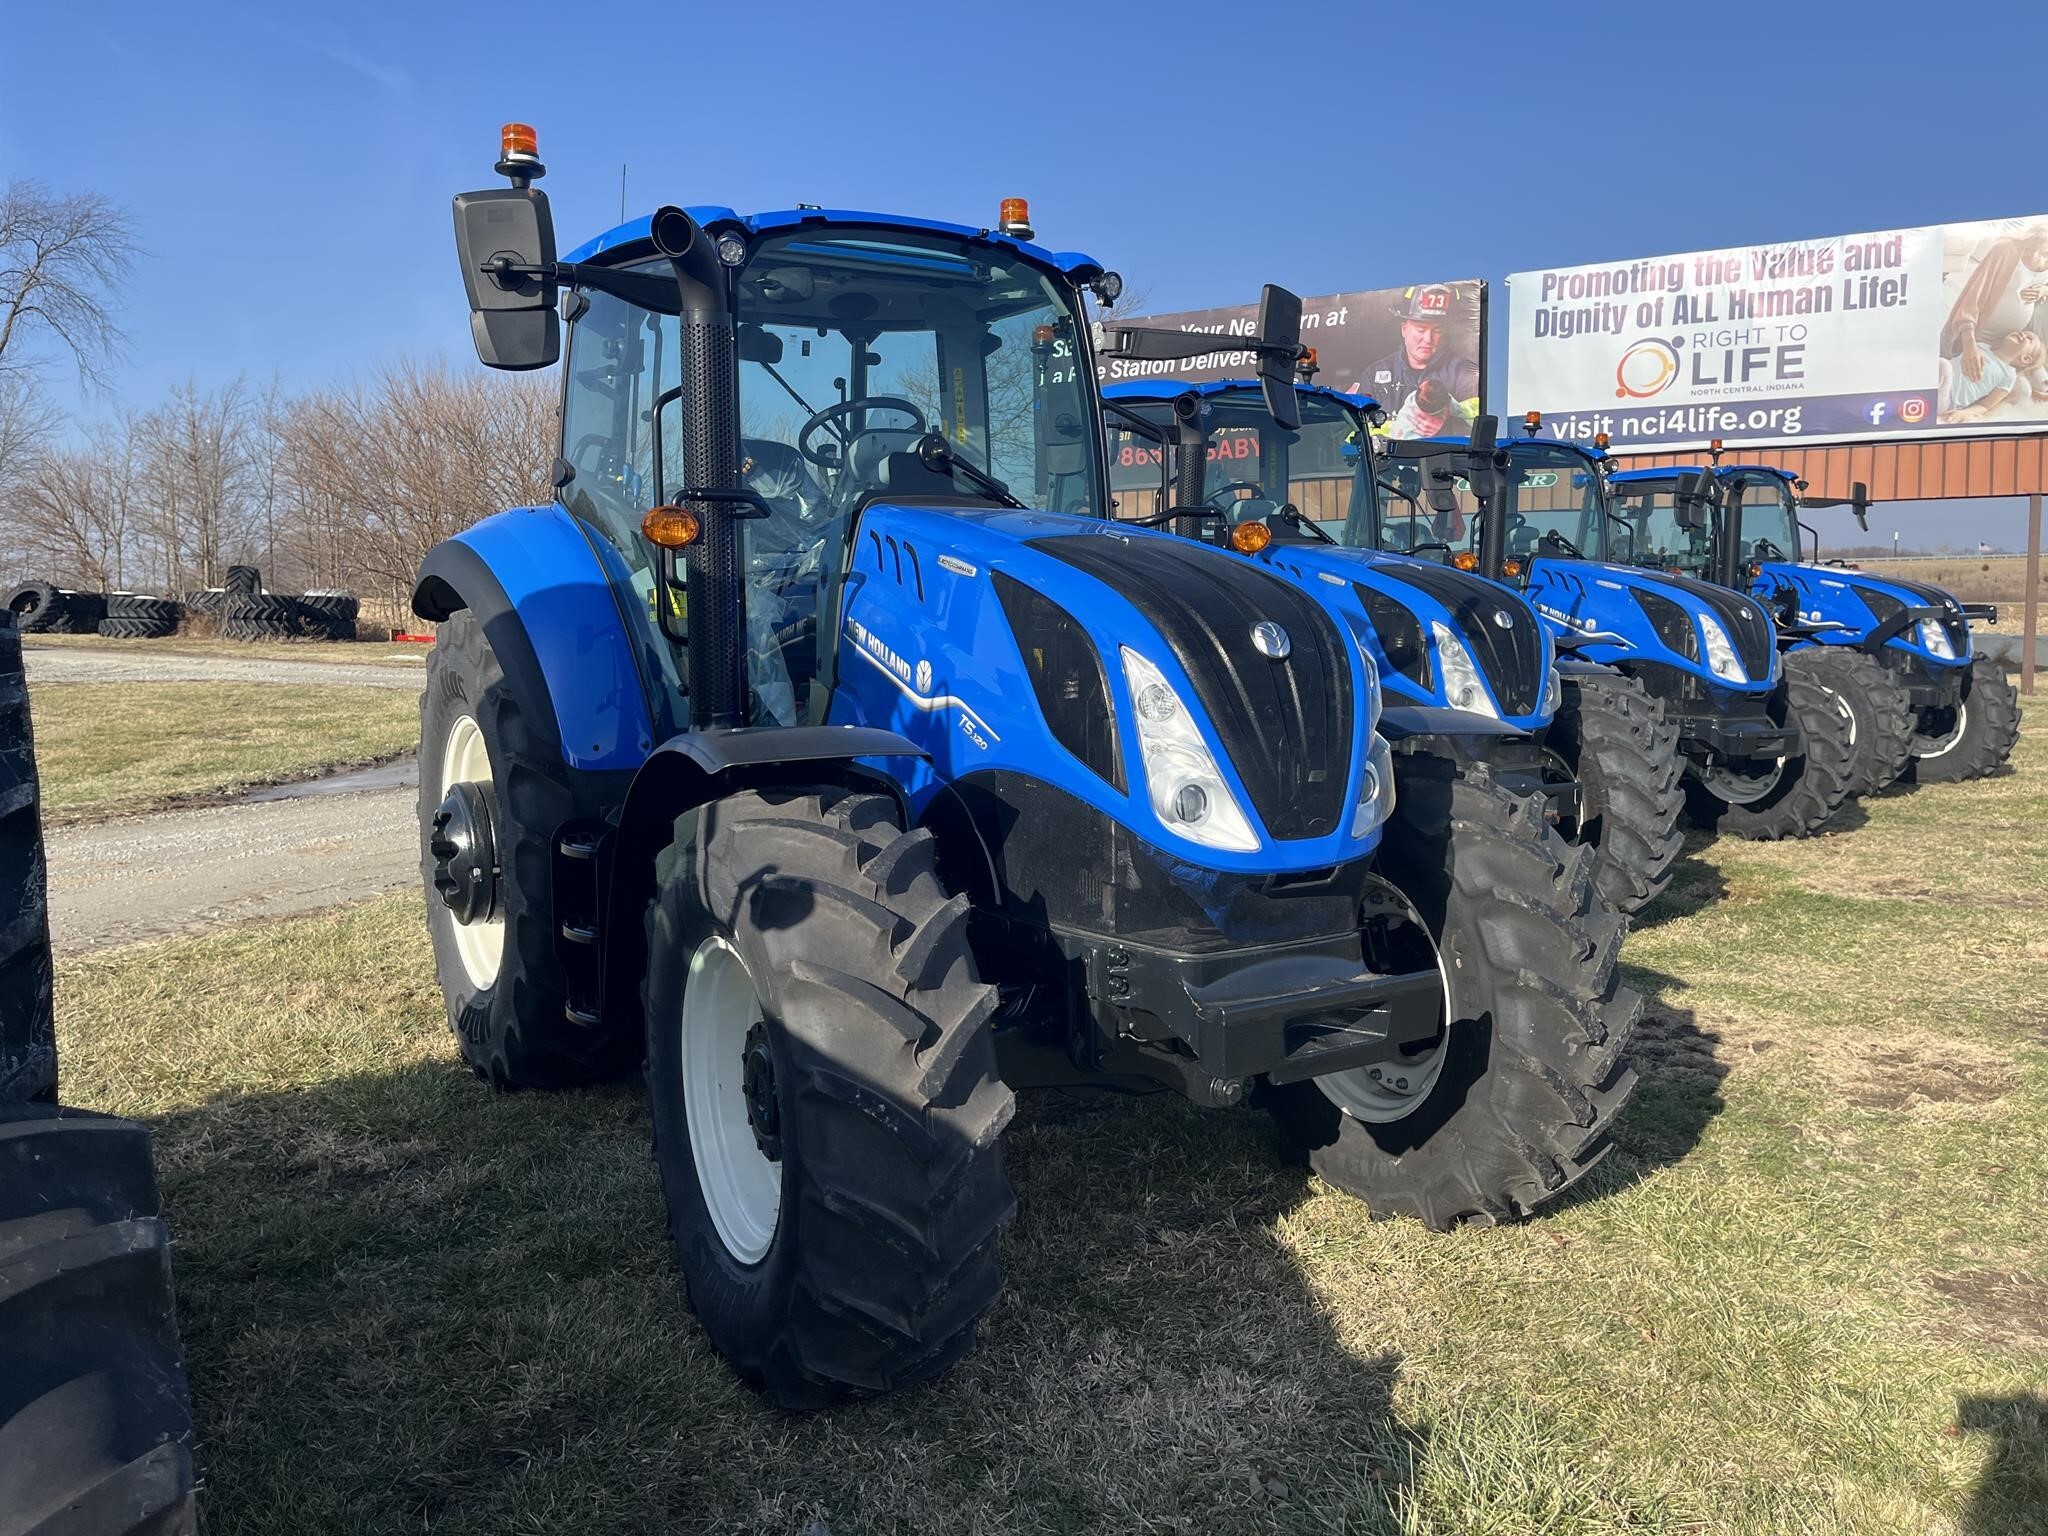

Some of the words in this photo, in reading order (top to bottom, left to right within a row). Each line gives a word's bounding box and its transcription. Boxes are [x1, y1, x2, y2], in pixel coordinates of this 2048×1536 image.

[1541, 261, 1685, 302] Promoting
[1694, 254, 1741, 287] the
[1751, 246, 1834, 281] Value
[1844, 235, 1903, 272] and
[1428, 294, 1445, 308] 73
[1535, 302, 1628, 339] Dignity
[1636, 296, 1665, 329] of
[1672, 292, 1719, 326] ALL
[1728, 284, 1833, 321] Human
[1843, 273, 1909, 311] Life!
[1228, 312, 1320, 337] Nern
[1325, 306, 1348, 326] at
[1692, 328, 1766, 349] RIGHT
[1775, 324, 1808, 342] TO
[1110, 359, 1175, 379] Station
[1180, 350, 1258, 372] Delivers
[1691, 343, 1806, 386] LIFE
[1690, 388, 1721, 397] NORTH
[1723, 385, 1764, 395] CENTRAL
[1766, 382, 1805, 391] INDIANA
[1551, 414, 1613, 439] visit
[1621, 406, 1802, 437] nci4life.org
[847, 615, 867, 645] NEW
[867, 631, 912, 683] HOLLAND
[958, 713, 988, 750] T5.120
